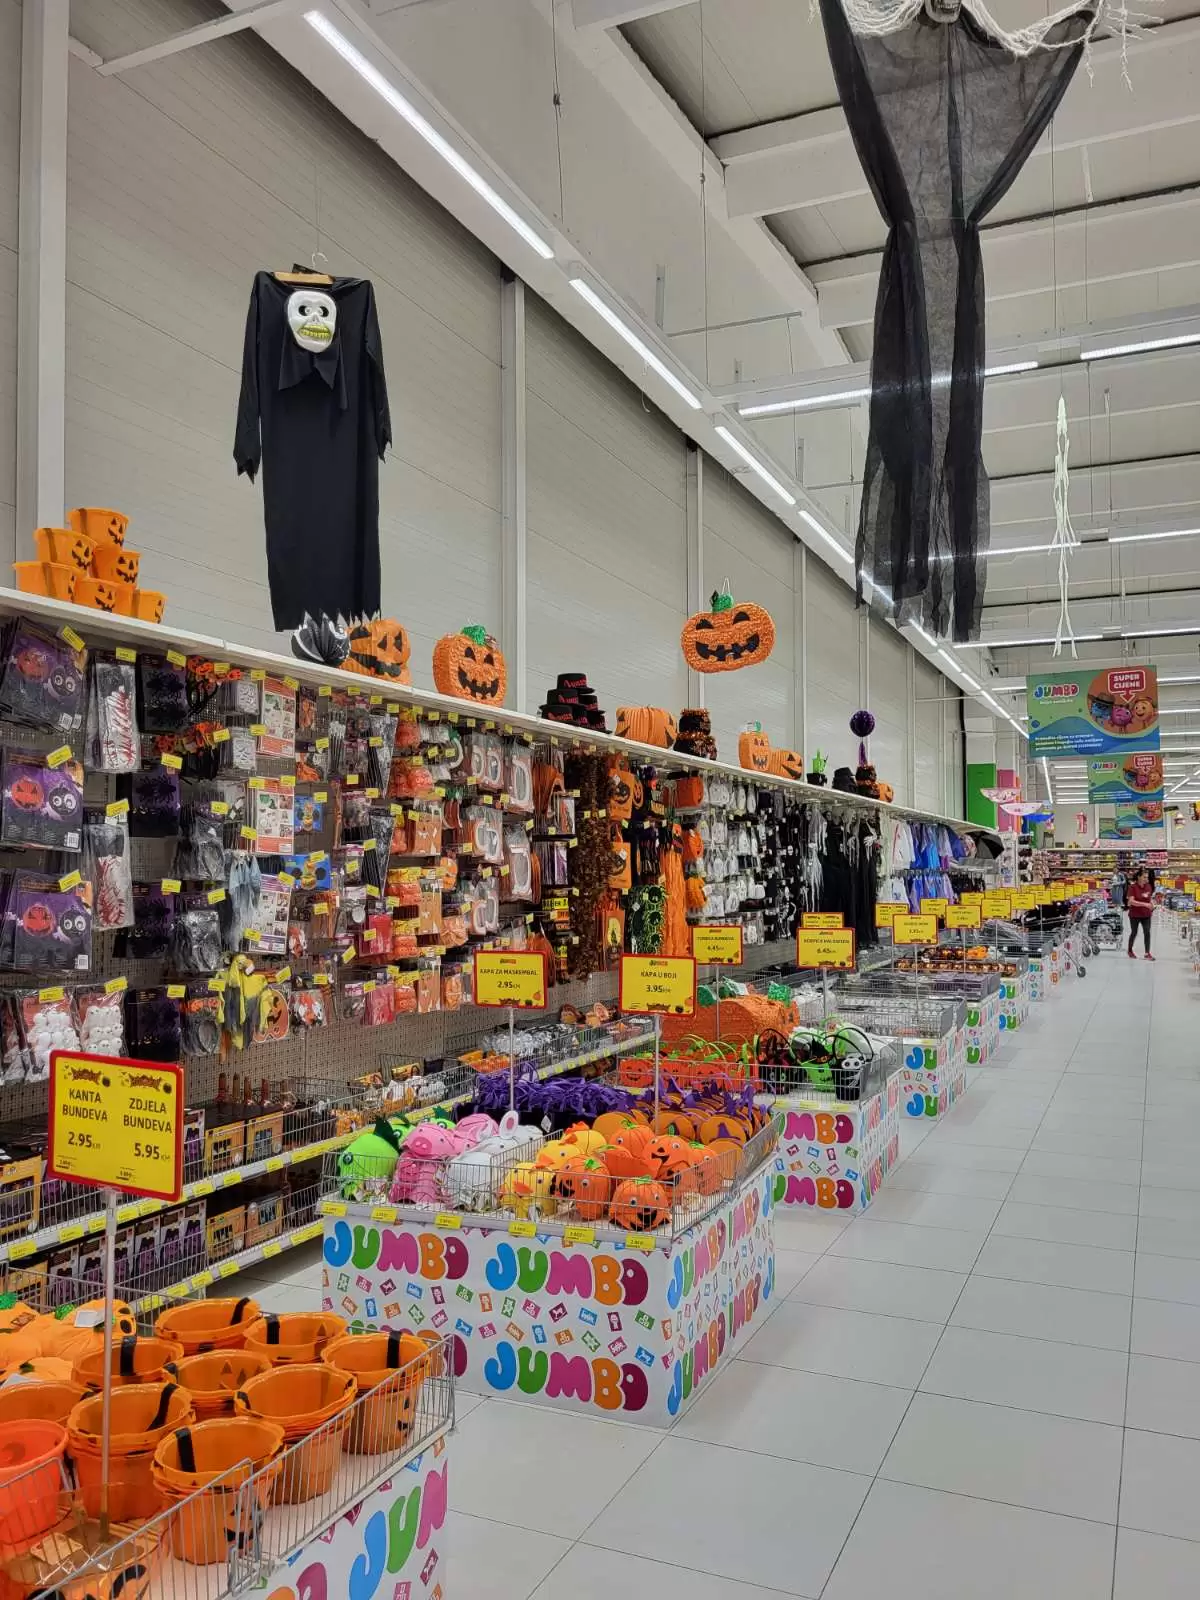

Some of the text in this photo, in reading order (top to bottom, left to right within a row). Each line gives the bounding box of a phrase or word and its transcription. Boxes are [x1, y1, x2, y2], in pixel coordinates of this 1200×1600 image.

[1113, 674, 1140, 682] SUPER
[1113, 681, 1140, 689] CIJENE
[1033, 683, 1080, 699] JUMBO
[497, 981, 512, 989] 2.95
[646, 985, 662, 993] 3.95
[69, 1088, 102, 1104] KANTA
[62, 1104, 108, 1122] BUNDEVA
[128, 1097, 167, 1115] ZDJELA
[123, 1114, 173, 1134] BUNDEVA
[68, 1131, 92, 1148] 2.95
[134, 1142, 160, 1160] 5.95
[323, 1220, 469, 1280] JUMBO
[667, 1218, 726, 1310] JUMBO
[485, 1241, 648, 1307] JUMBO
[667, 1311, 726, 1417] JUMBO
[484, 1340, 648, 1411] JUMBO
